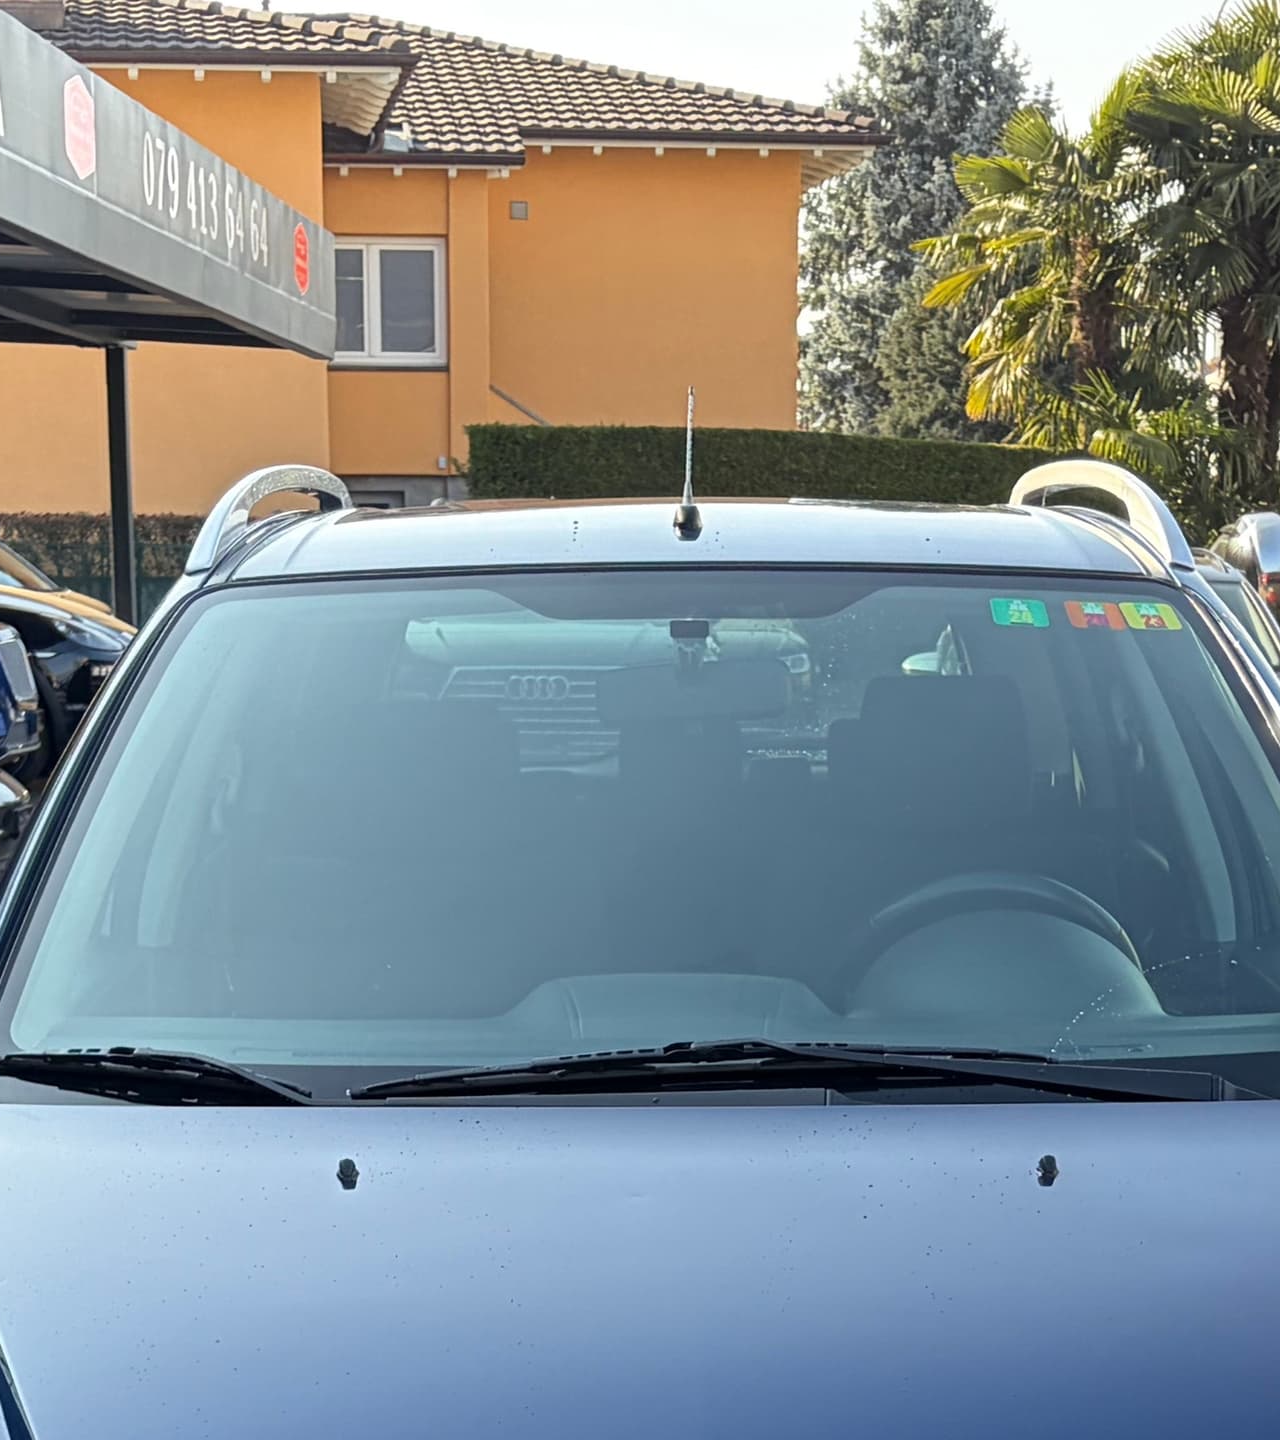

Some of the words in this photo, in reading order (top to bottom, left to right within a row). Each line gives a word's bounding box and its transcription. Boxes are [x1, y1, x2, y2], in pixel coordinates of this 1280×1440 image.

[143, 131, 179, 219] 079
[187, 160, 218, 241] 413
[224, 182, 244, 253] 64
[250, 199, 268, 267] 64
